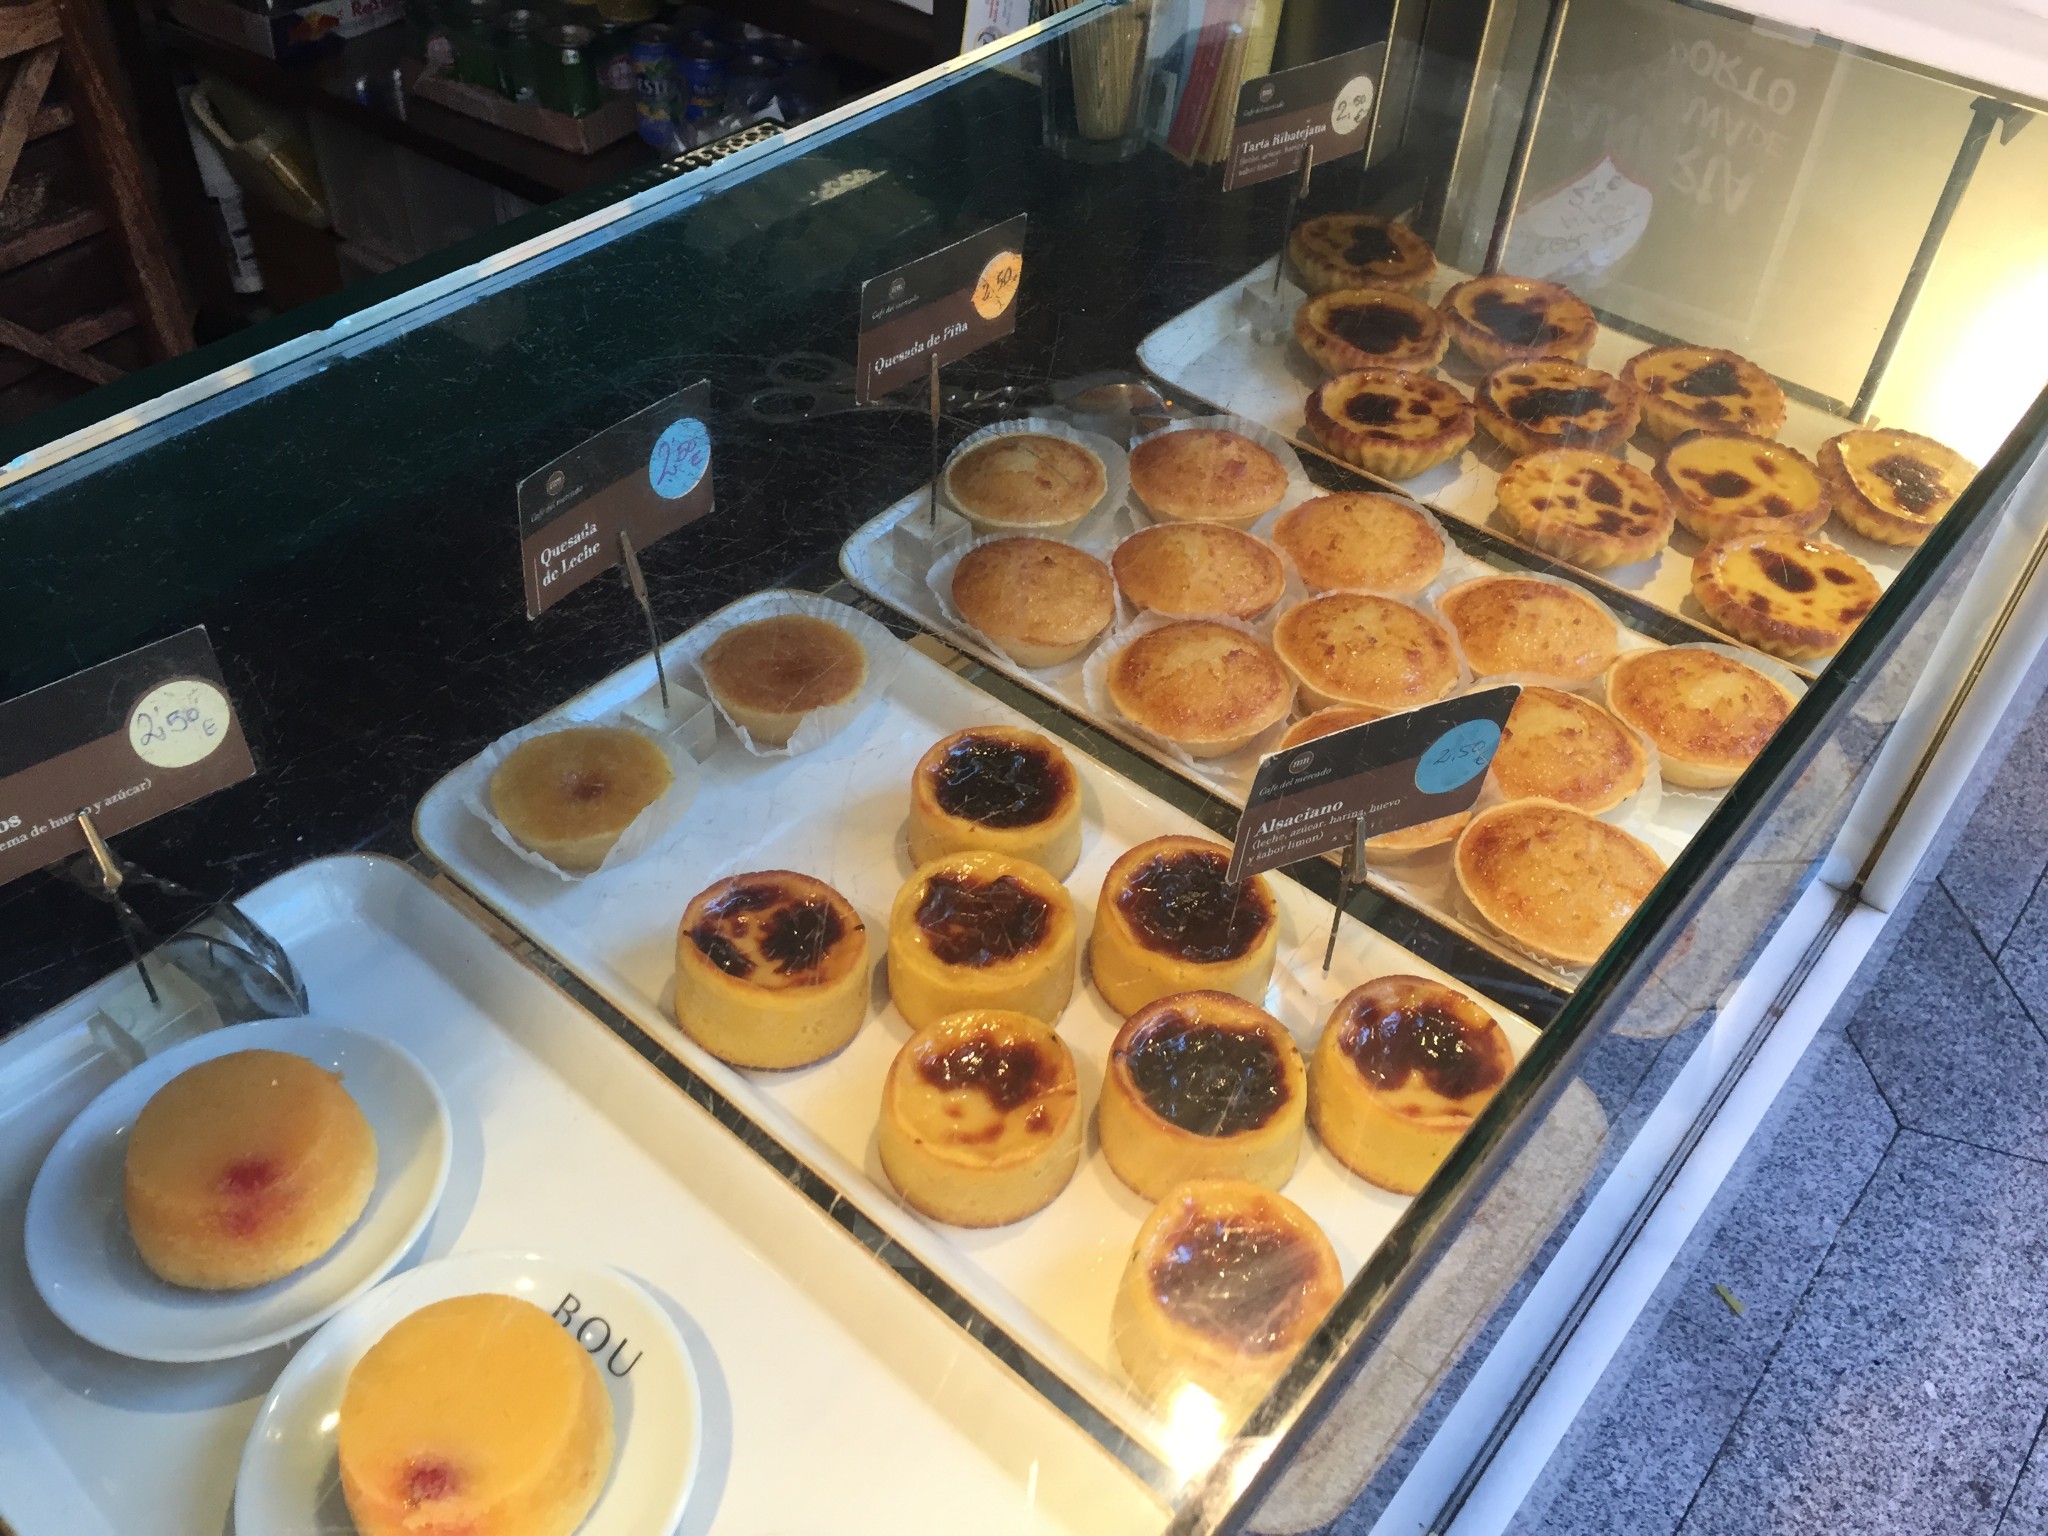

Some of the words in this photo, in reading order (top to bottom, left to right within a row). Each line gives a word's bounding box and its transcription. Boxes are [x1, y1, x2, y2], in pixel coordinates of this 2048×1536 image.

[1242, 139, 1270, 154] Tarta
[874, 341, 925, 375] Quesada
[926, 333, 941, 349] de
[540, 521, 598, 568] Quesada
[542, 569, 559, 587] de
[560, 542, 600, 575] Leche
[1279, 777, 1295, 790] del
[1294, 767, 1332, 785] mercado
[30, 825, 48, 838] de
[48, 806, 92, 830] hueo
[92, 801, 102, 815] y
[103, 777, 152, 807] azúcar)
[1253, 800, 1344, 838] Alsaciano
[1368, 798, 1401, 814] huevo
[1246, 855, 1256, 867] y
